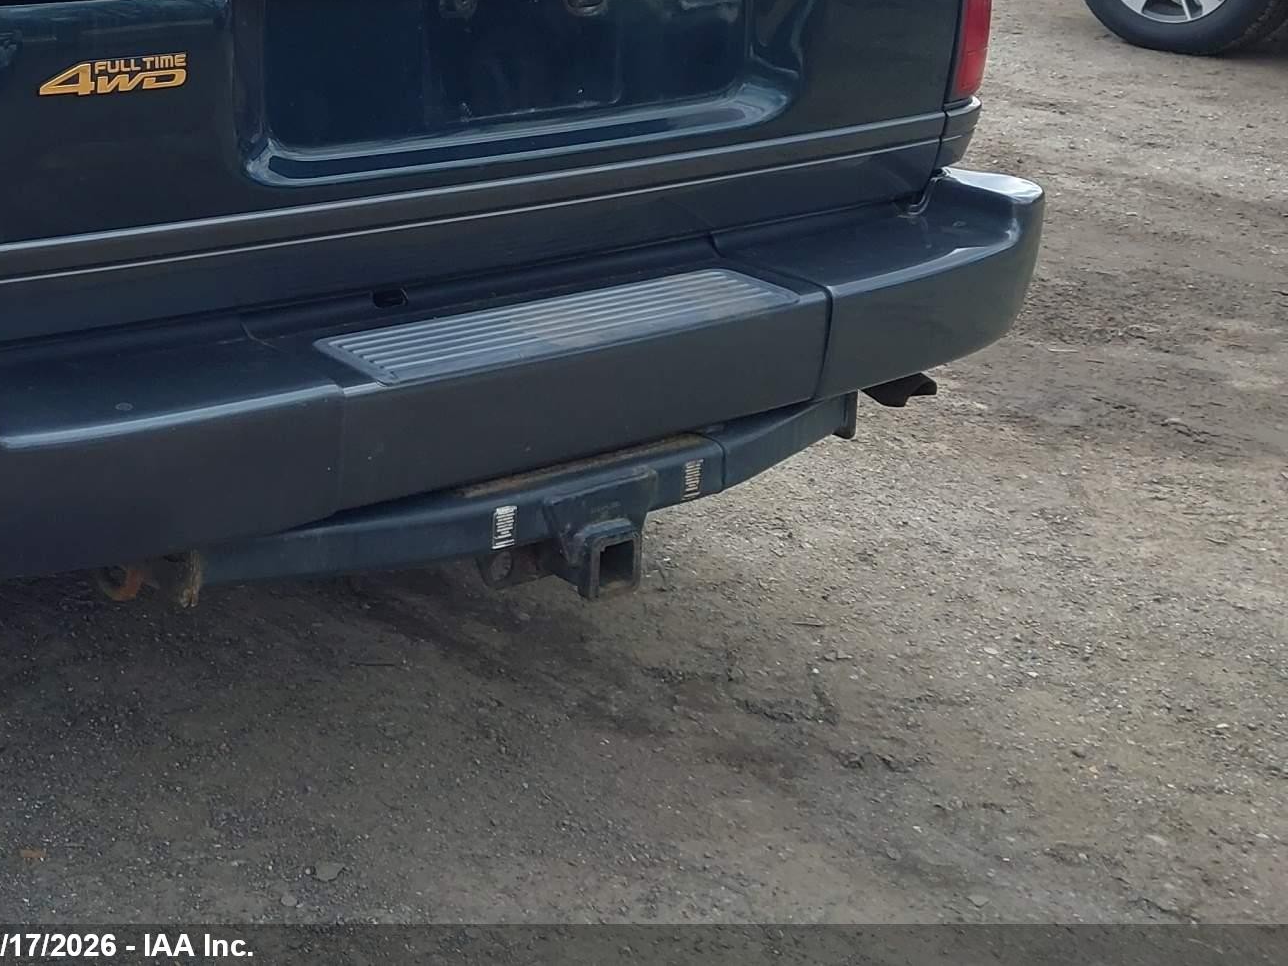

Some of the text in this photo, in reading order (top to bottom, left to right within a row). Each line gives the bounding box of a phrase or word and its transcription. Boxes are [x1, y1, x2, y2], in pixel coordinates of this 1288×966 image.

[95, 53, 187, 75] FULL TIME
[39, 63, 187, 96] 4WD
